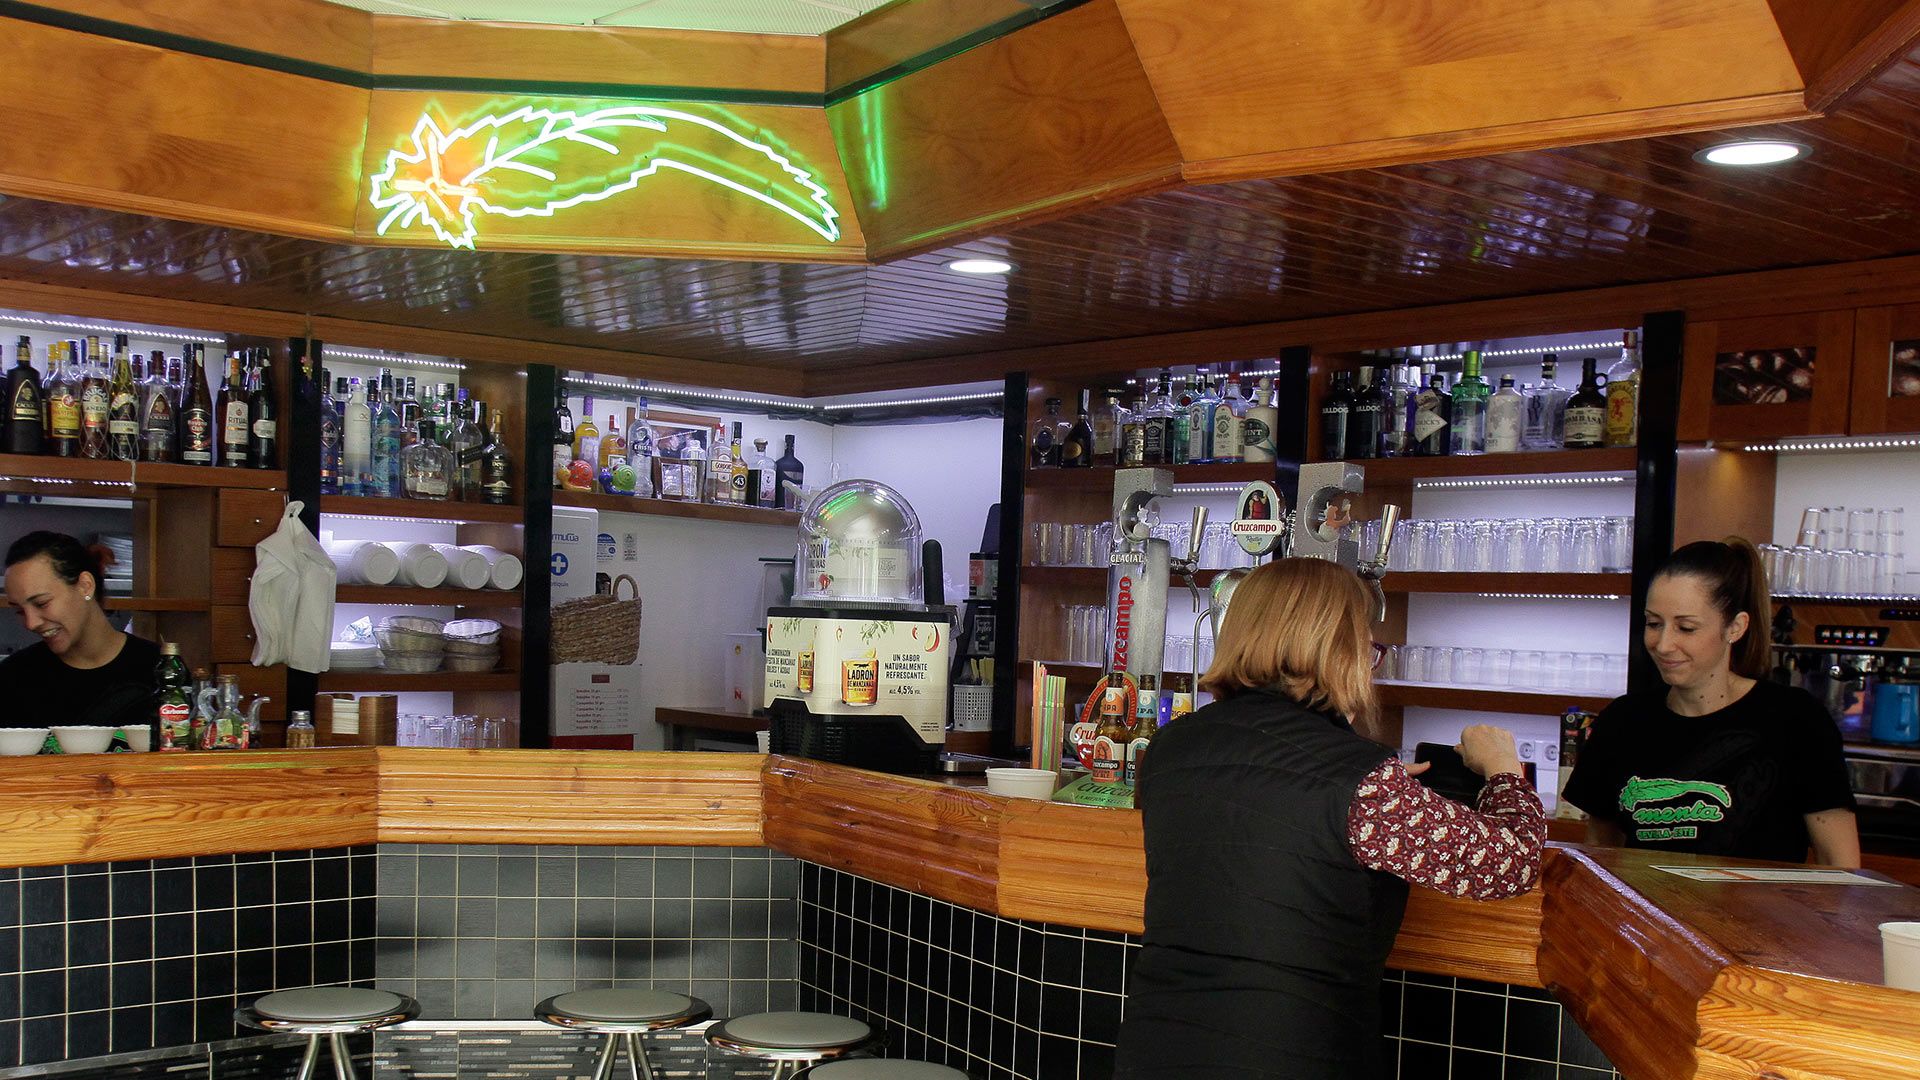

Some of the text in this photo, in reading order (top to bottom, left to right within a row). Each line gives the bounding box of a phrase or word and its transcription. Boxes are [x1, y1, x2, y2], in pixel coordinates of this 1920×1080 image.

[734, 477, 745, 485] 43
[1233, 521, 1277, 533] Cruzcampo
[1110, 553, 1144, 563] GLACIAL
[892, 654, 920, 662] UN SABOR
[884, 662, 928, 671] NATURALMENTE
[886, 671, 926, 680] REFRESCANTE.
[897, 686, 914, 695] 4,5%
[1633, 800, 1724, 824] menta
